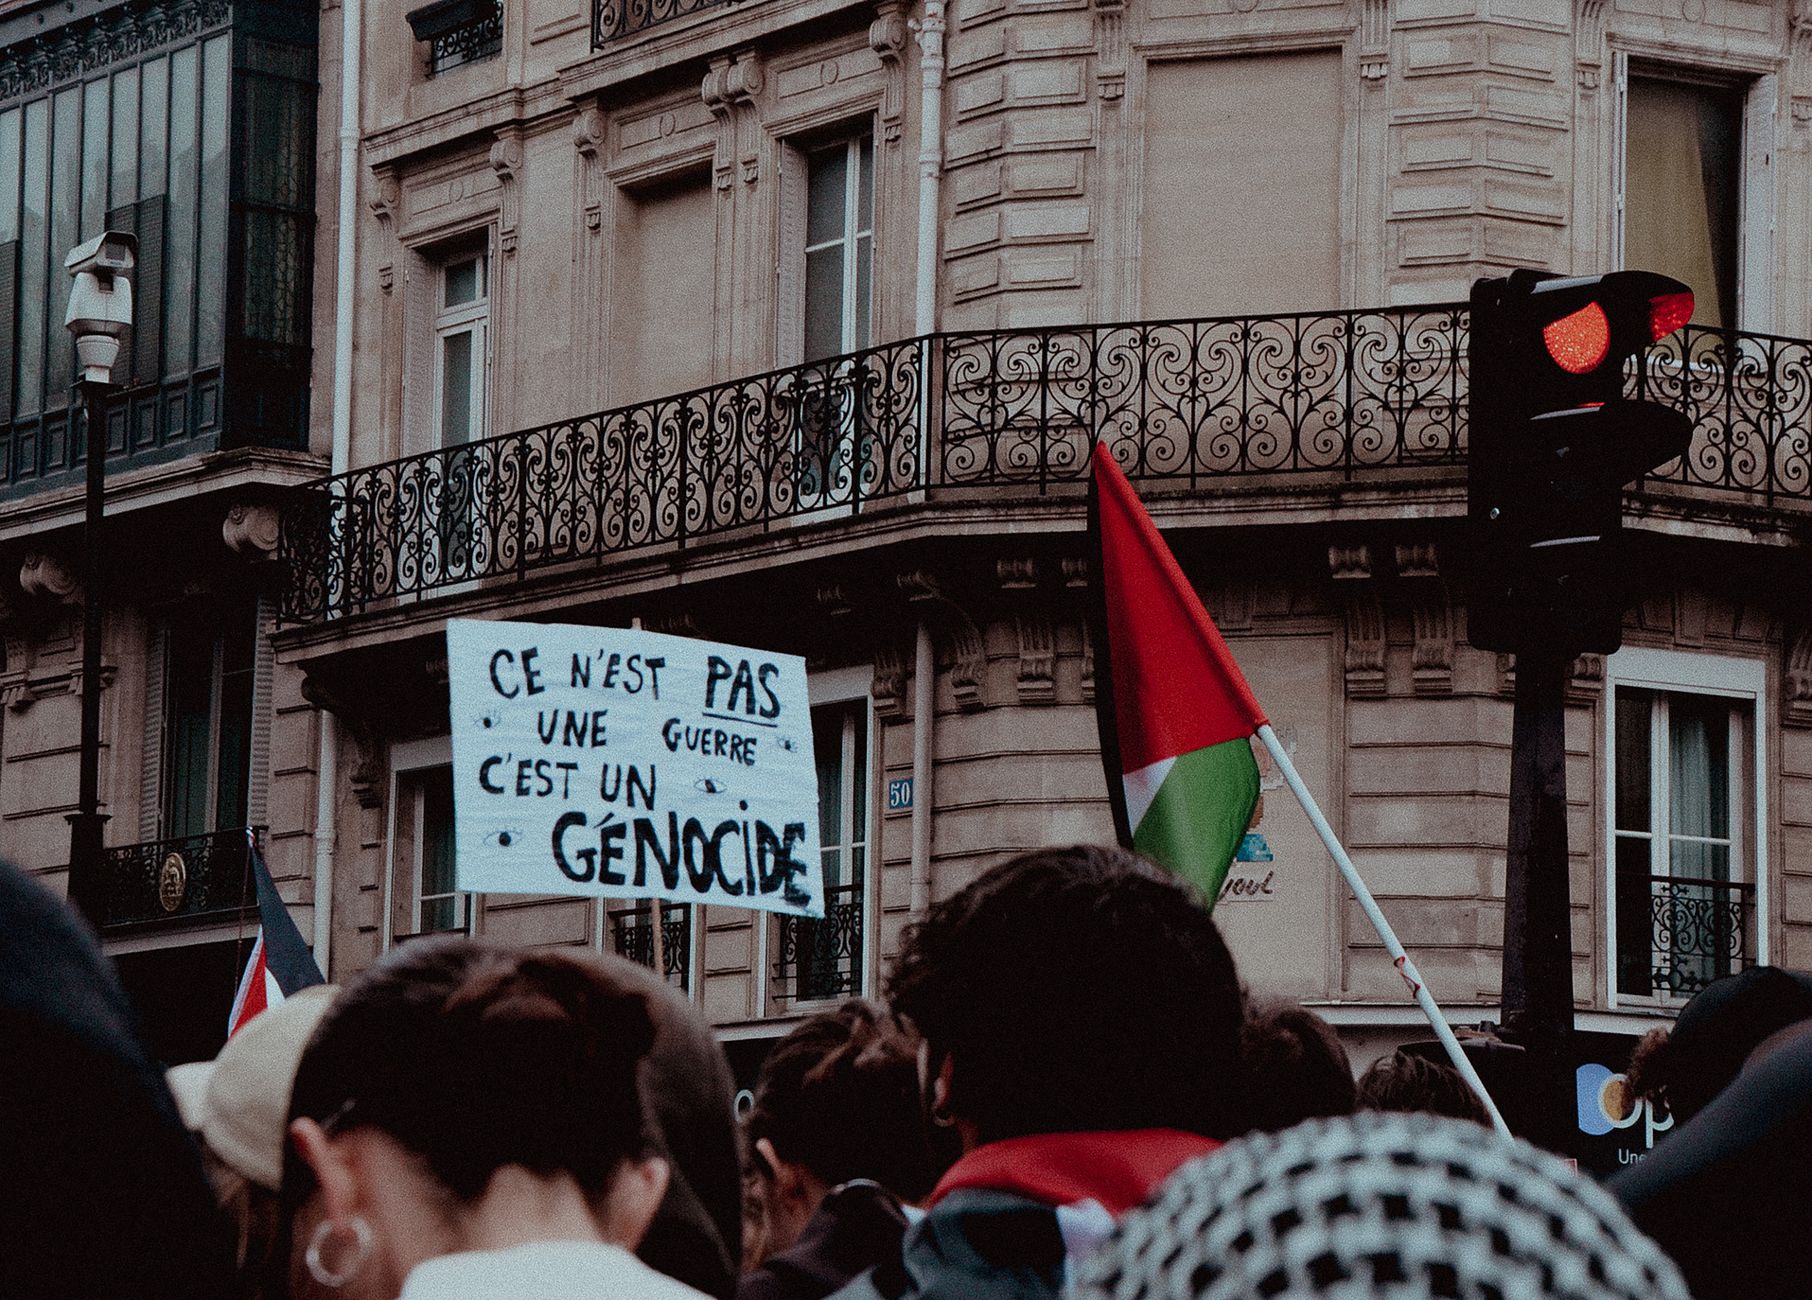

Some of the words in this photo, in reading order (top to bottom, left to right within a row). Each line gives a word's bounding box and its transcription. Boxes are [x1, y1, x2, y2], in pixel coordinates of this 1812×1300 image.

[489, 646, 546, 699] CE
[570, 649, 666, 700] N'EST
[704, 655, 781, 719] PAS
[537, 709, 608, 748] UNE
[661, 718, 758, 766] GUERRE
[478, 753, 579, 800] C'EST
[600, 763, 656, 811] UN
[890, 781, 910, 807] 50
